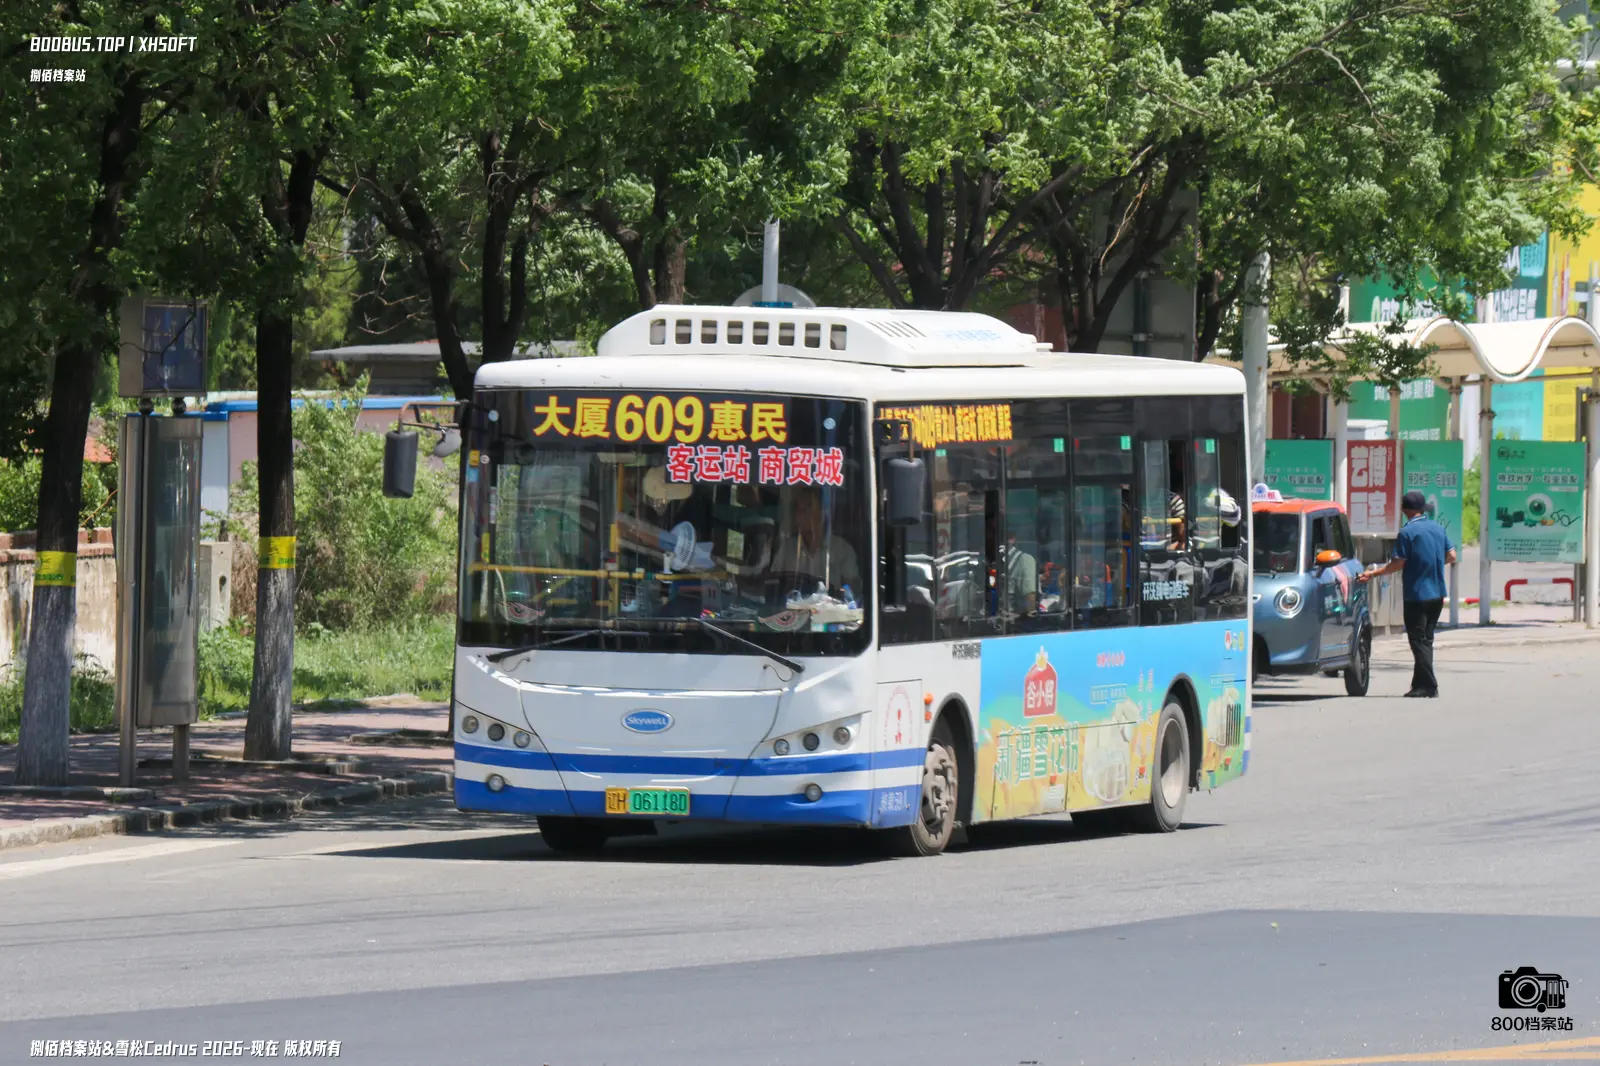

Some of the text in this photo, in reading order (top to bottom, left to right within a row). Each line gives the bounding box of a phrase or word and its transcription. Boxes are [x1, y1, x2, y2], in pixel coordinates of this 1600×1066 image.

[533, 394, 787, 443] 大厦 609 惠民
[667, 444, 844, 486] 客运站 商贸城
